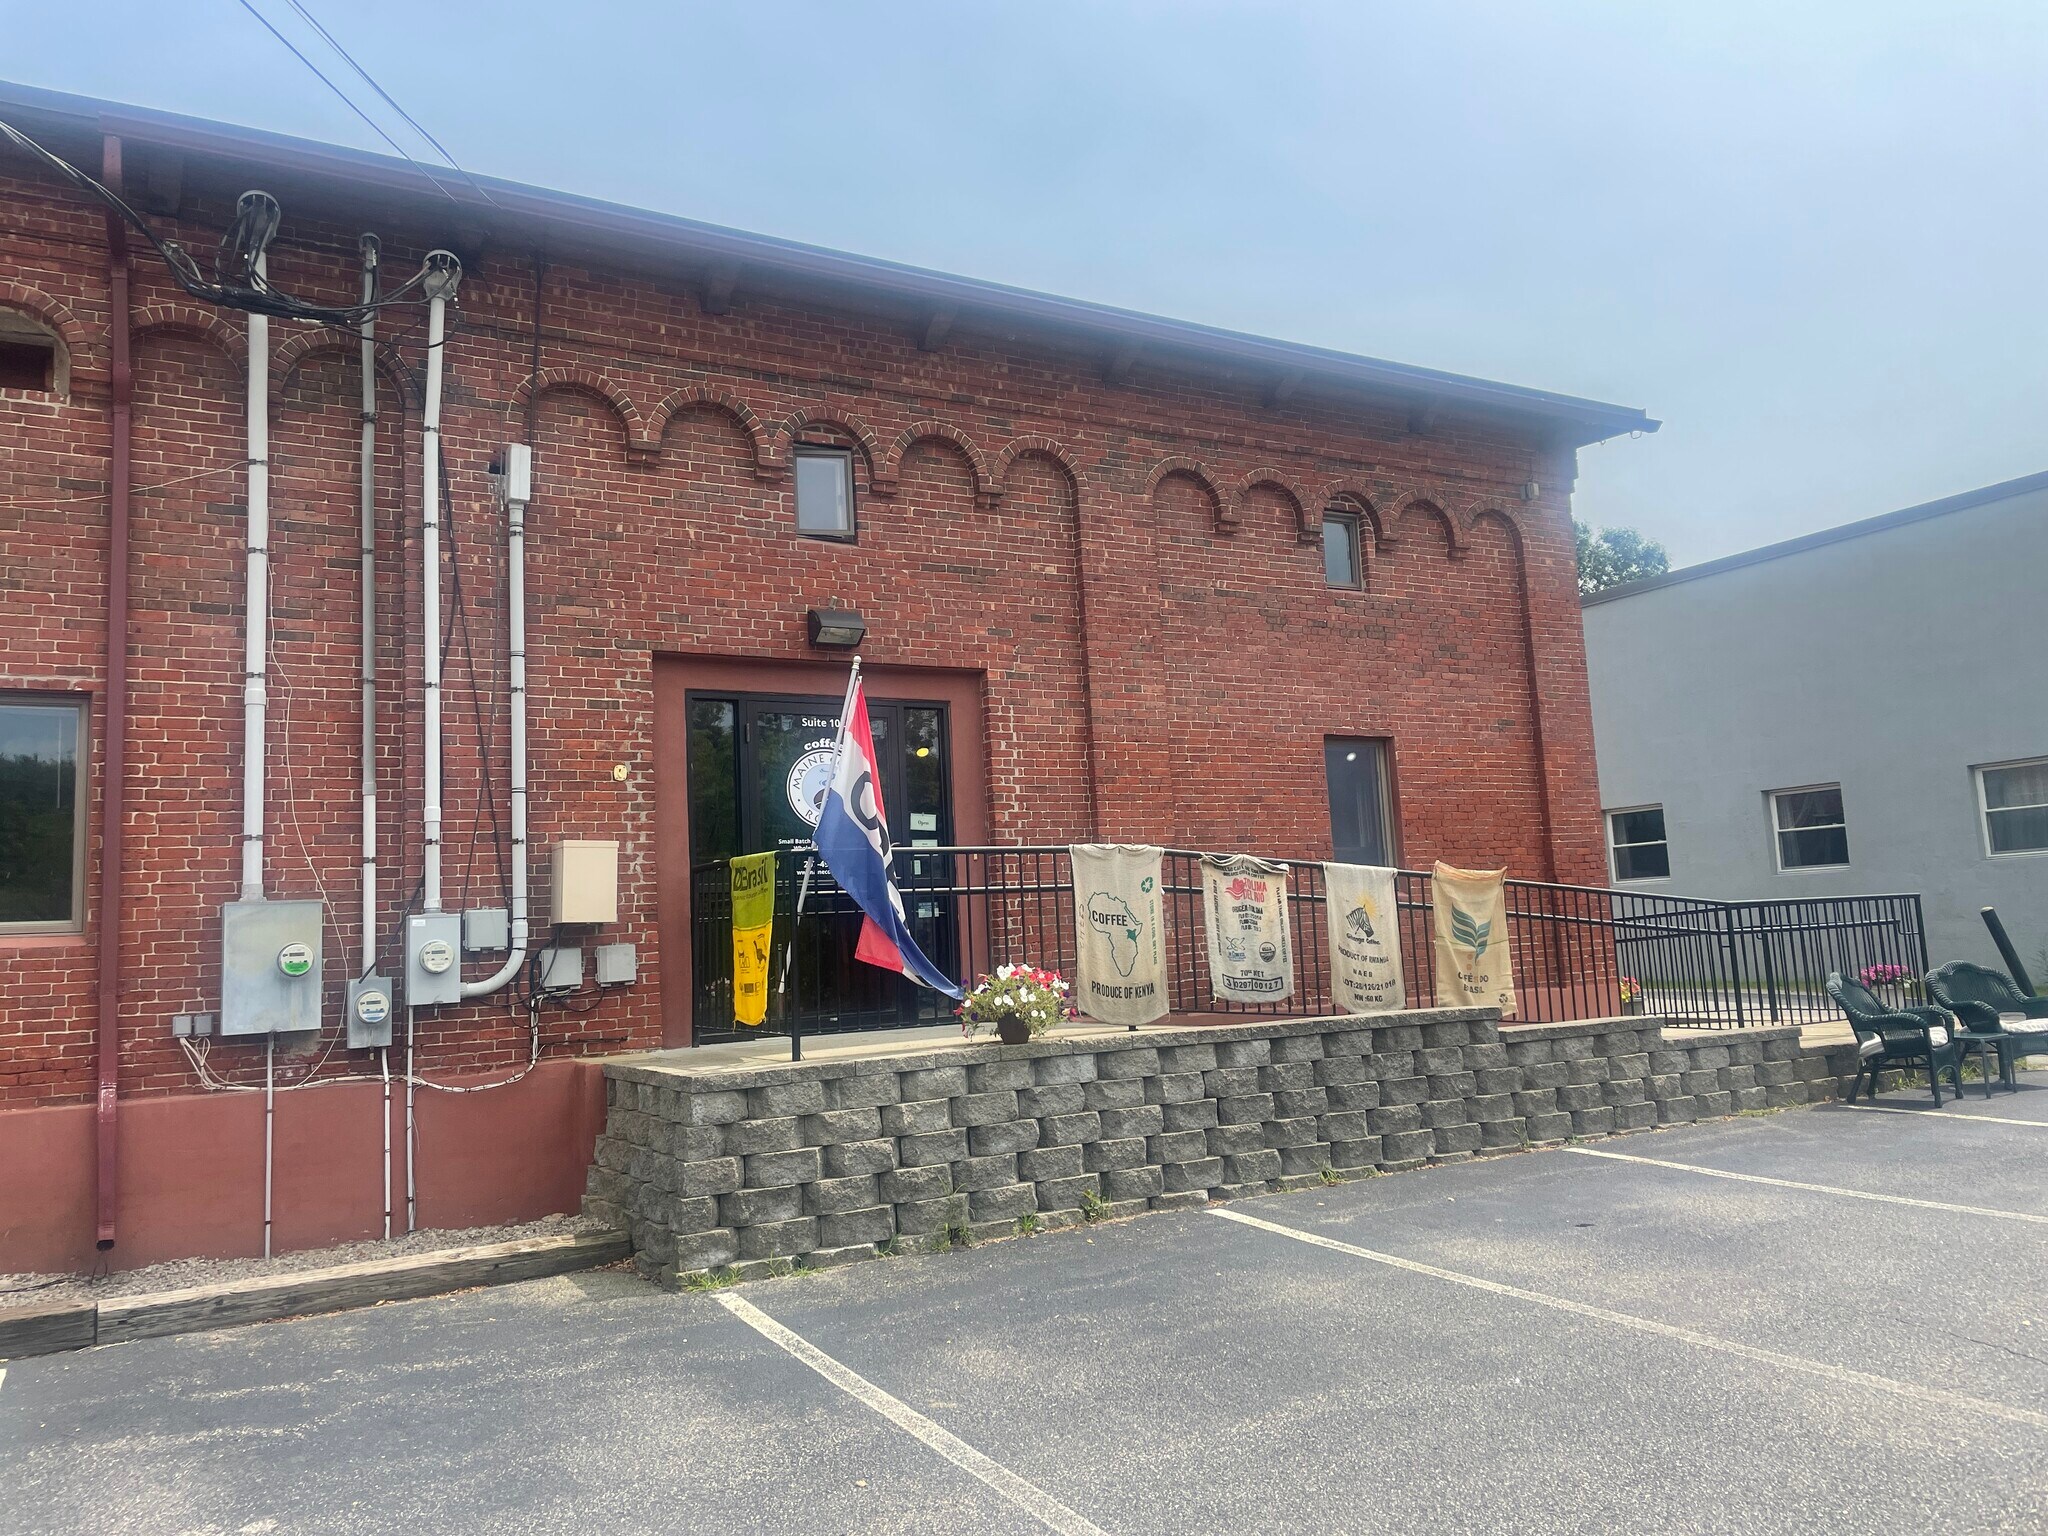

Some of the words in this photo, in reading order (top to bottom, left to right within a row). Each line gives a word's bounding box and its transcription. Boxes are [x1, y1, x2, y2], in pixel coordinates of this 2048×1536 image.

[801, 717, 827, 728] Suite
[793, 754, 825, 790] MAINE
[1243, 878, 1267, 892] TOLIMA
[1243, 890, 1253, 901] DEL
[1254, 891, 1265, 903] RIO
[1092, 910, 1128, 927] COFFEE
[1360, 955, 1368, 963] OF
[1253, 970, 1264, 978] NET
[1091, 981, 1122, 999] PRODUCE
[1124, 986, 1133, 999] OF
[1135, 982, 1155, 999] KENYA
[1226, 978, 1232, 987] 3
[1254, 981, 1279, 990] 00127
